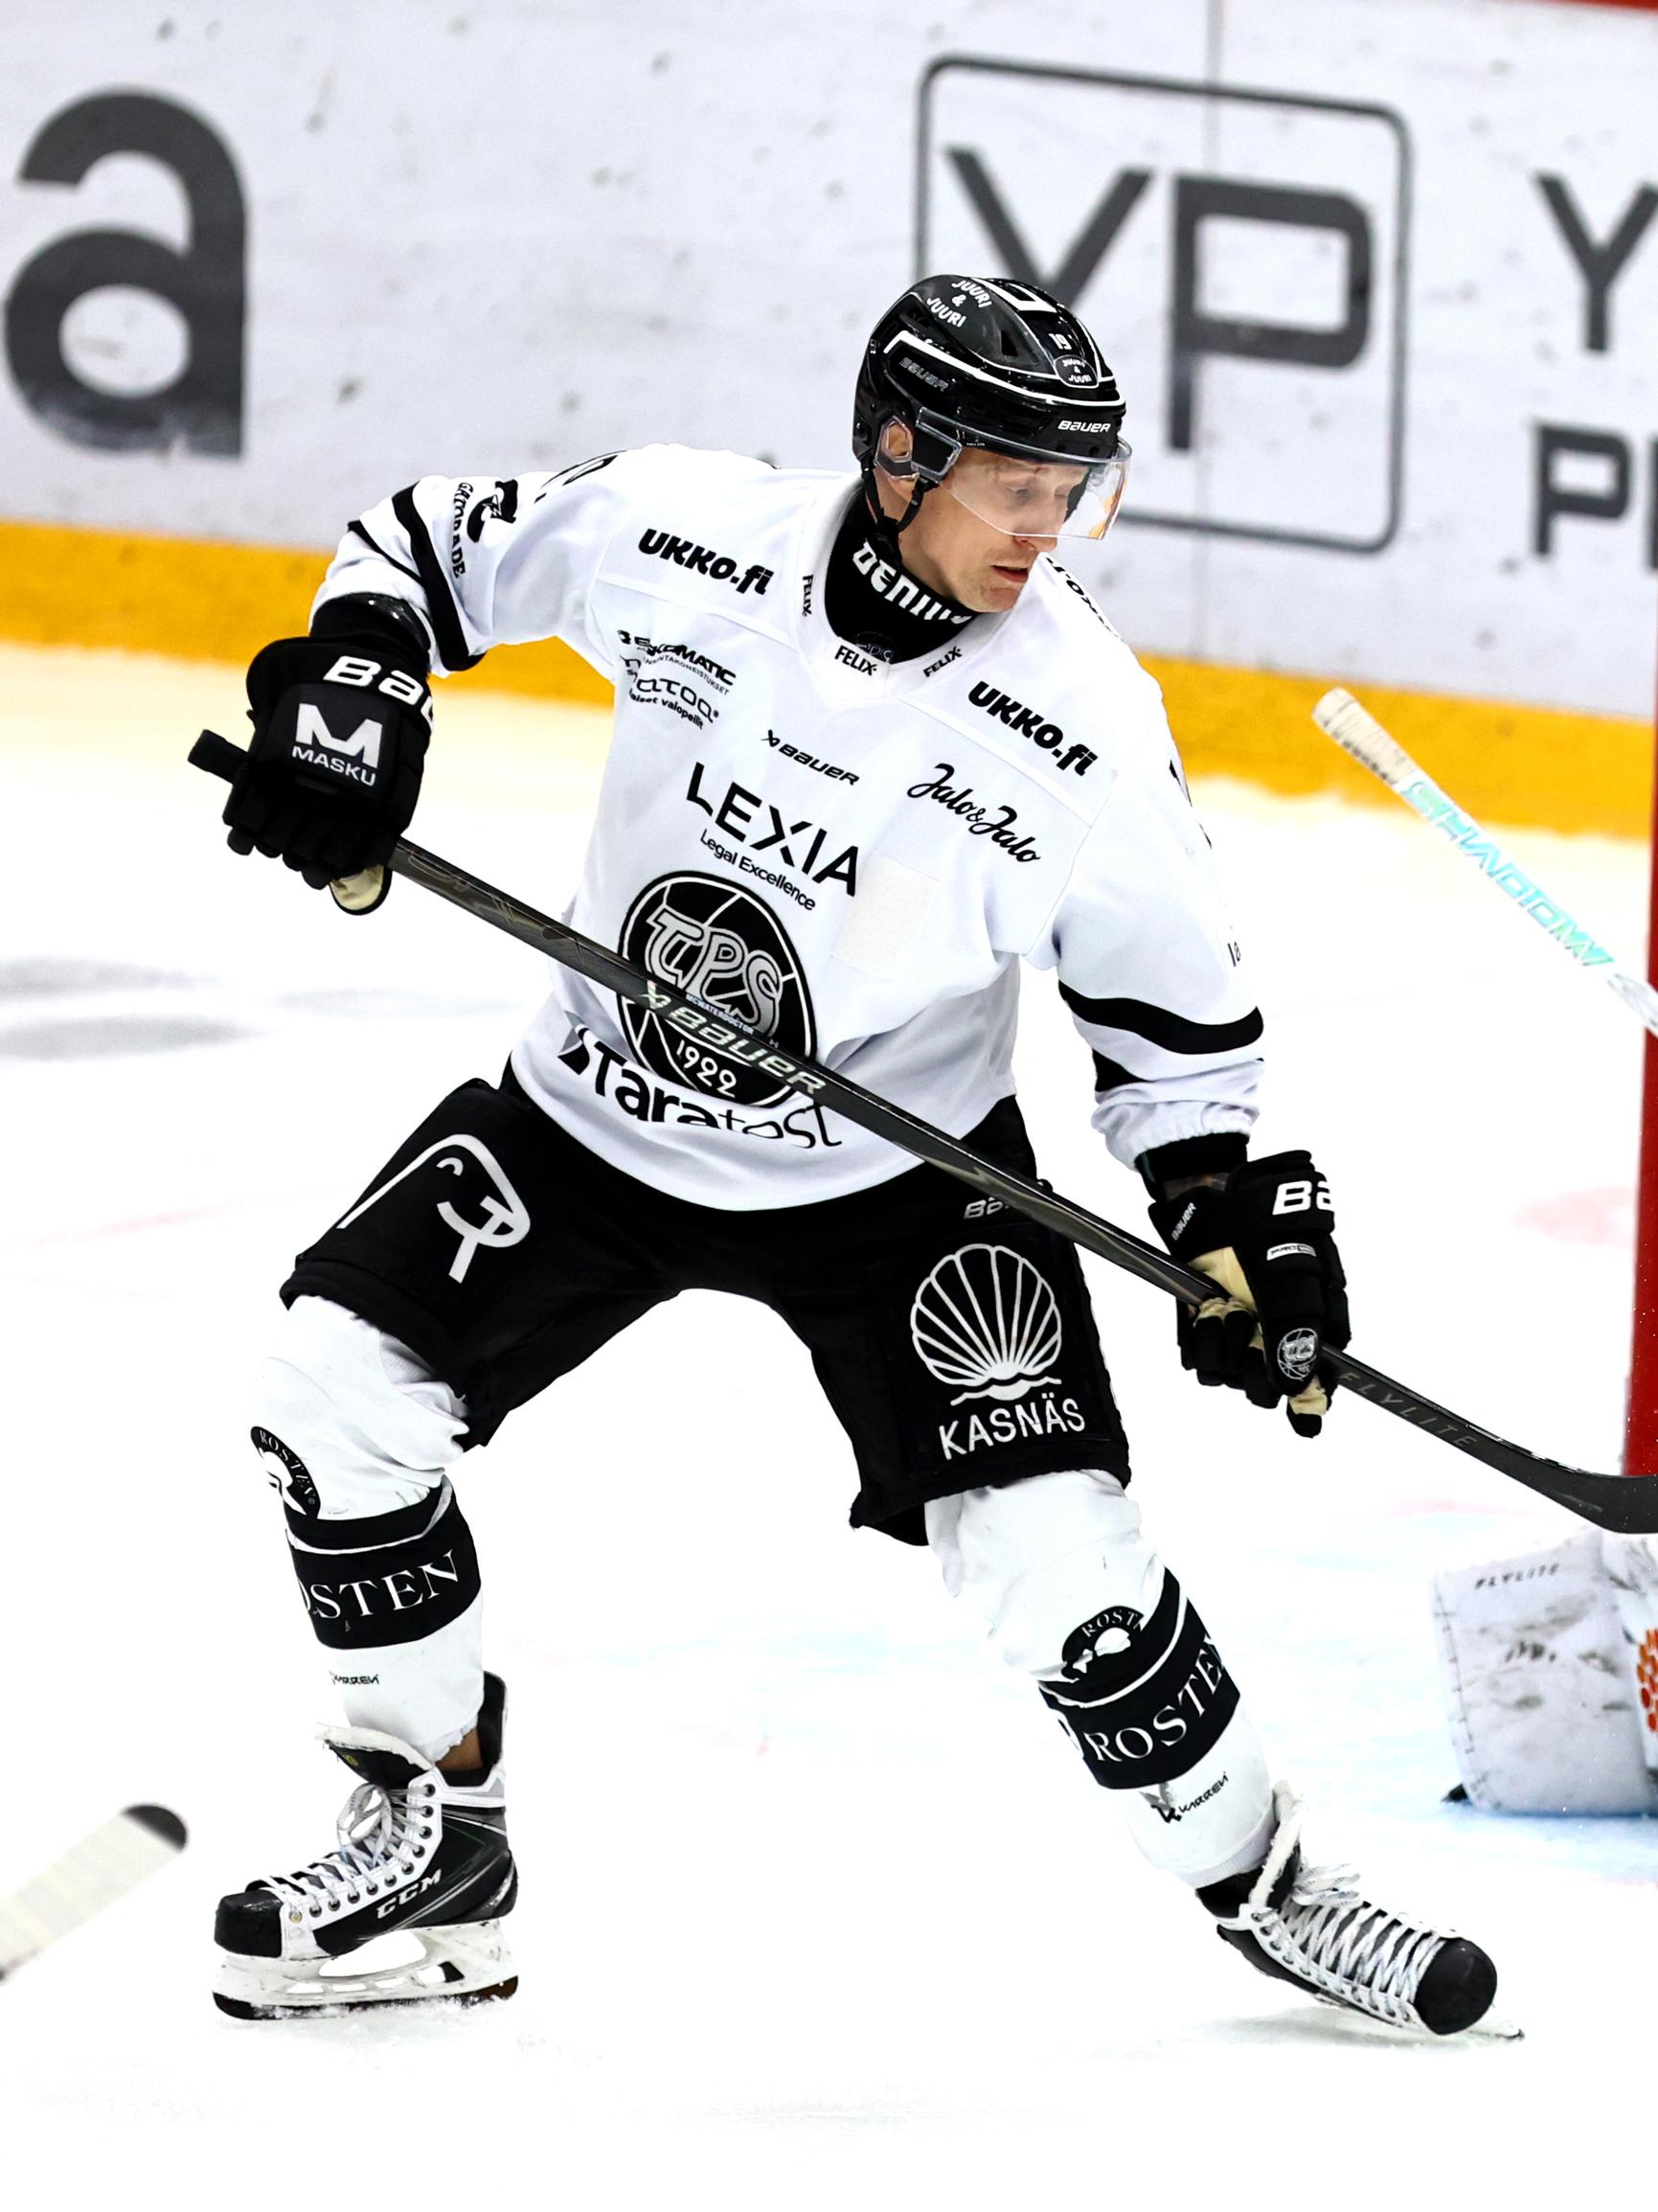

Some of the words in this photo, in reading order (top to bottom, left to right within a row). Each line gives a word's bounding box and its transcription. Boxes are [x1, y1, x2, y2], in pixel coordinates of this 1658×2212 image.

[926, 297, 967, 328] JUURI
[944, 147, 1373, 450] YP
[951, 280, 992, 308] JUURI
[952, 295, 964, 307] &
[1048, 333, 1072, 350] 19
[1057, 420, 1111, 433] BAUER
[1534, 422, 1658, 571] P
[638, 528, 774, 595] UKKO.fi
[923, 646, 962, 677] FELIX
[967, 681, 1098, 776] UKKO.fi
[292, 745, 375, 787] MASKU
[779, 743, 860, 786] BAUER
[686, 762, 859, 898] LEXIA
[700, 828, 737, 866] Legal
[738, 855, 816, 911] Excellence
[646, 904, 784, 1036] TPS
[669, 1007, 826, 1094] BAUER
[675, 1040, 737, 1099] 1922
[939, 1393, 1086, 1460] KASNÄS
[1339, 1372, 1478, 1447] FLYLITE
[375, 1869, 442, 1919] CCM
